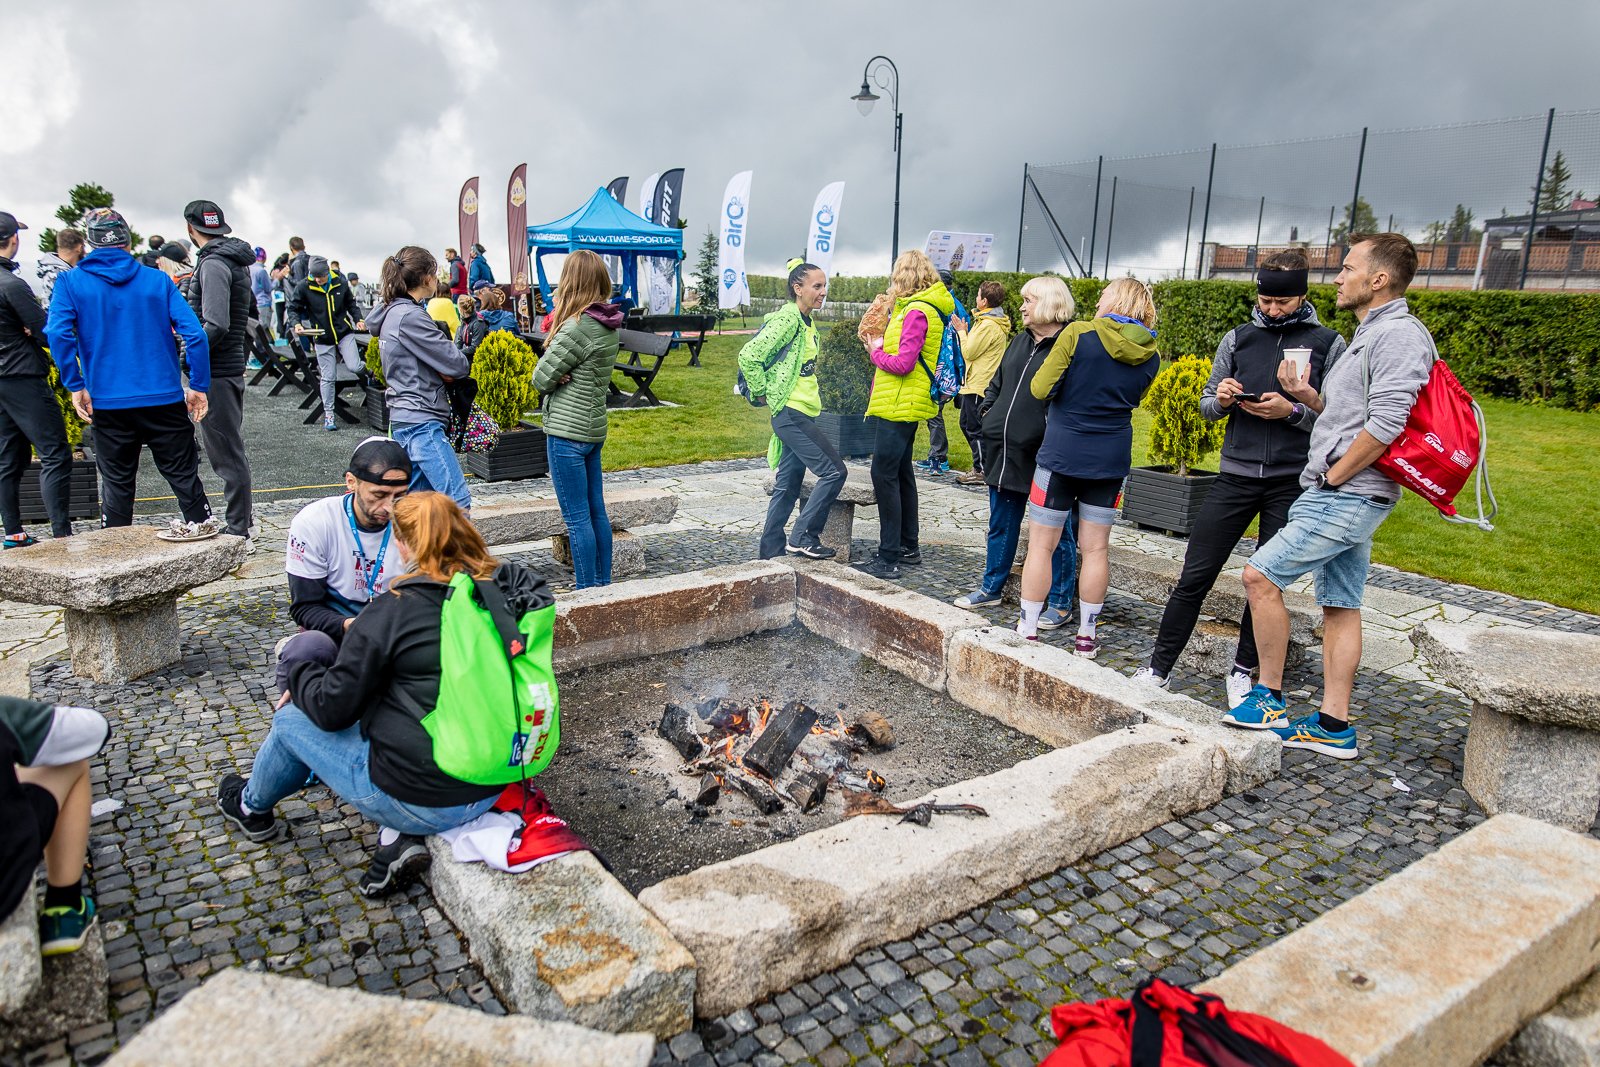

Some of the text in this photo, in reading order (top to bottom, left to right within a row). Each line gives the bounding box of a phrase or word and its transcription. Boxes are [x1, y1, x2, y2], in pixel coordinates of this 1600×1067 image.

[578, 234, 676, 245] WWW.TIME-SPORT.PL
[1394, 458, 1446, 495] SOLANO
[530, 733, 548, 763] 70.3
